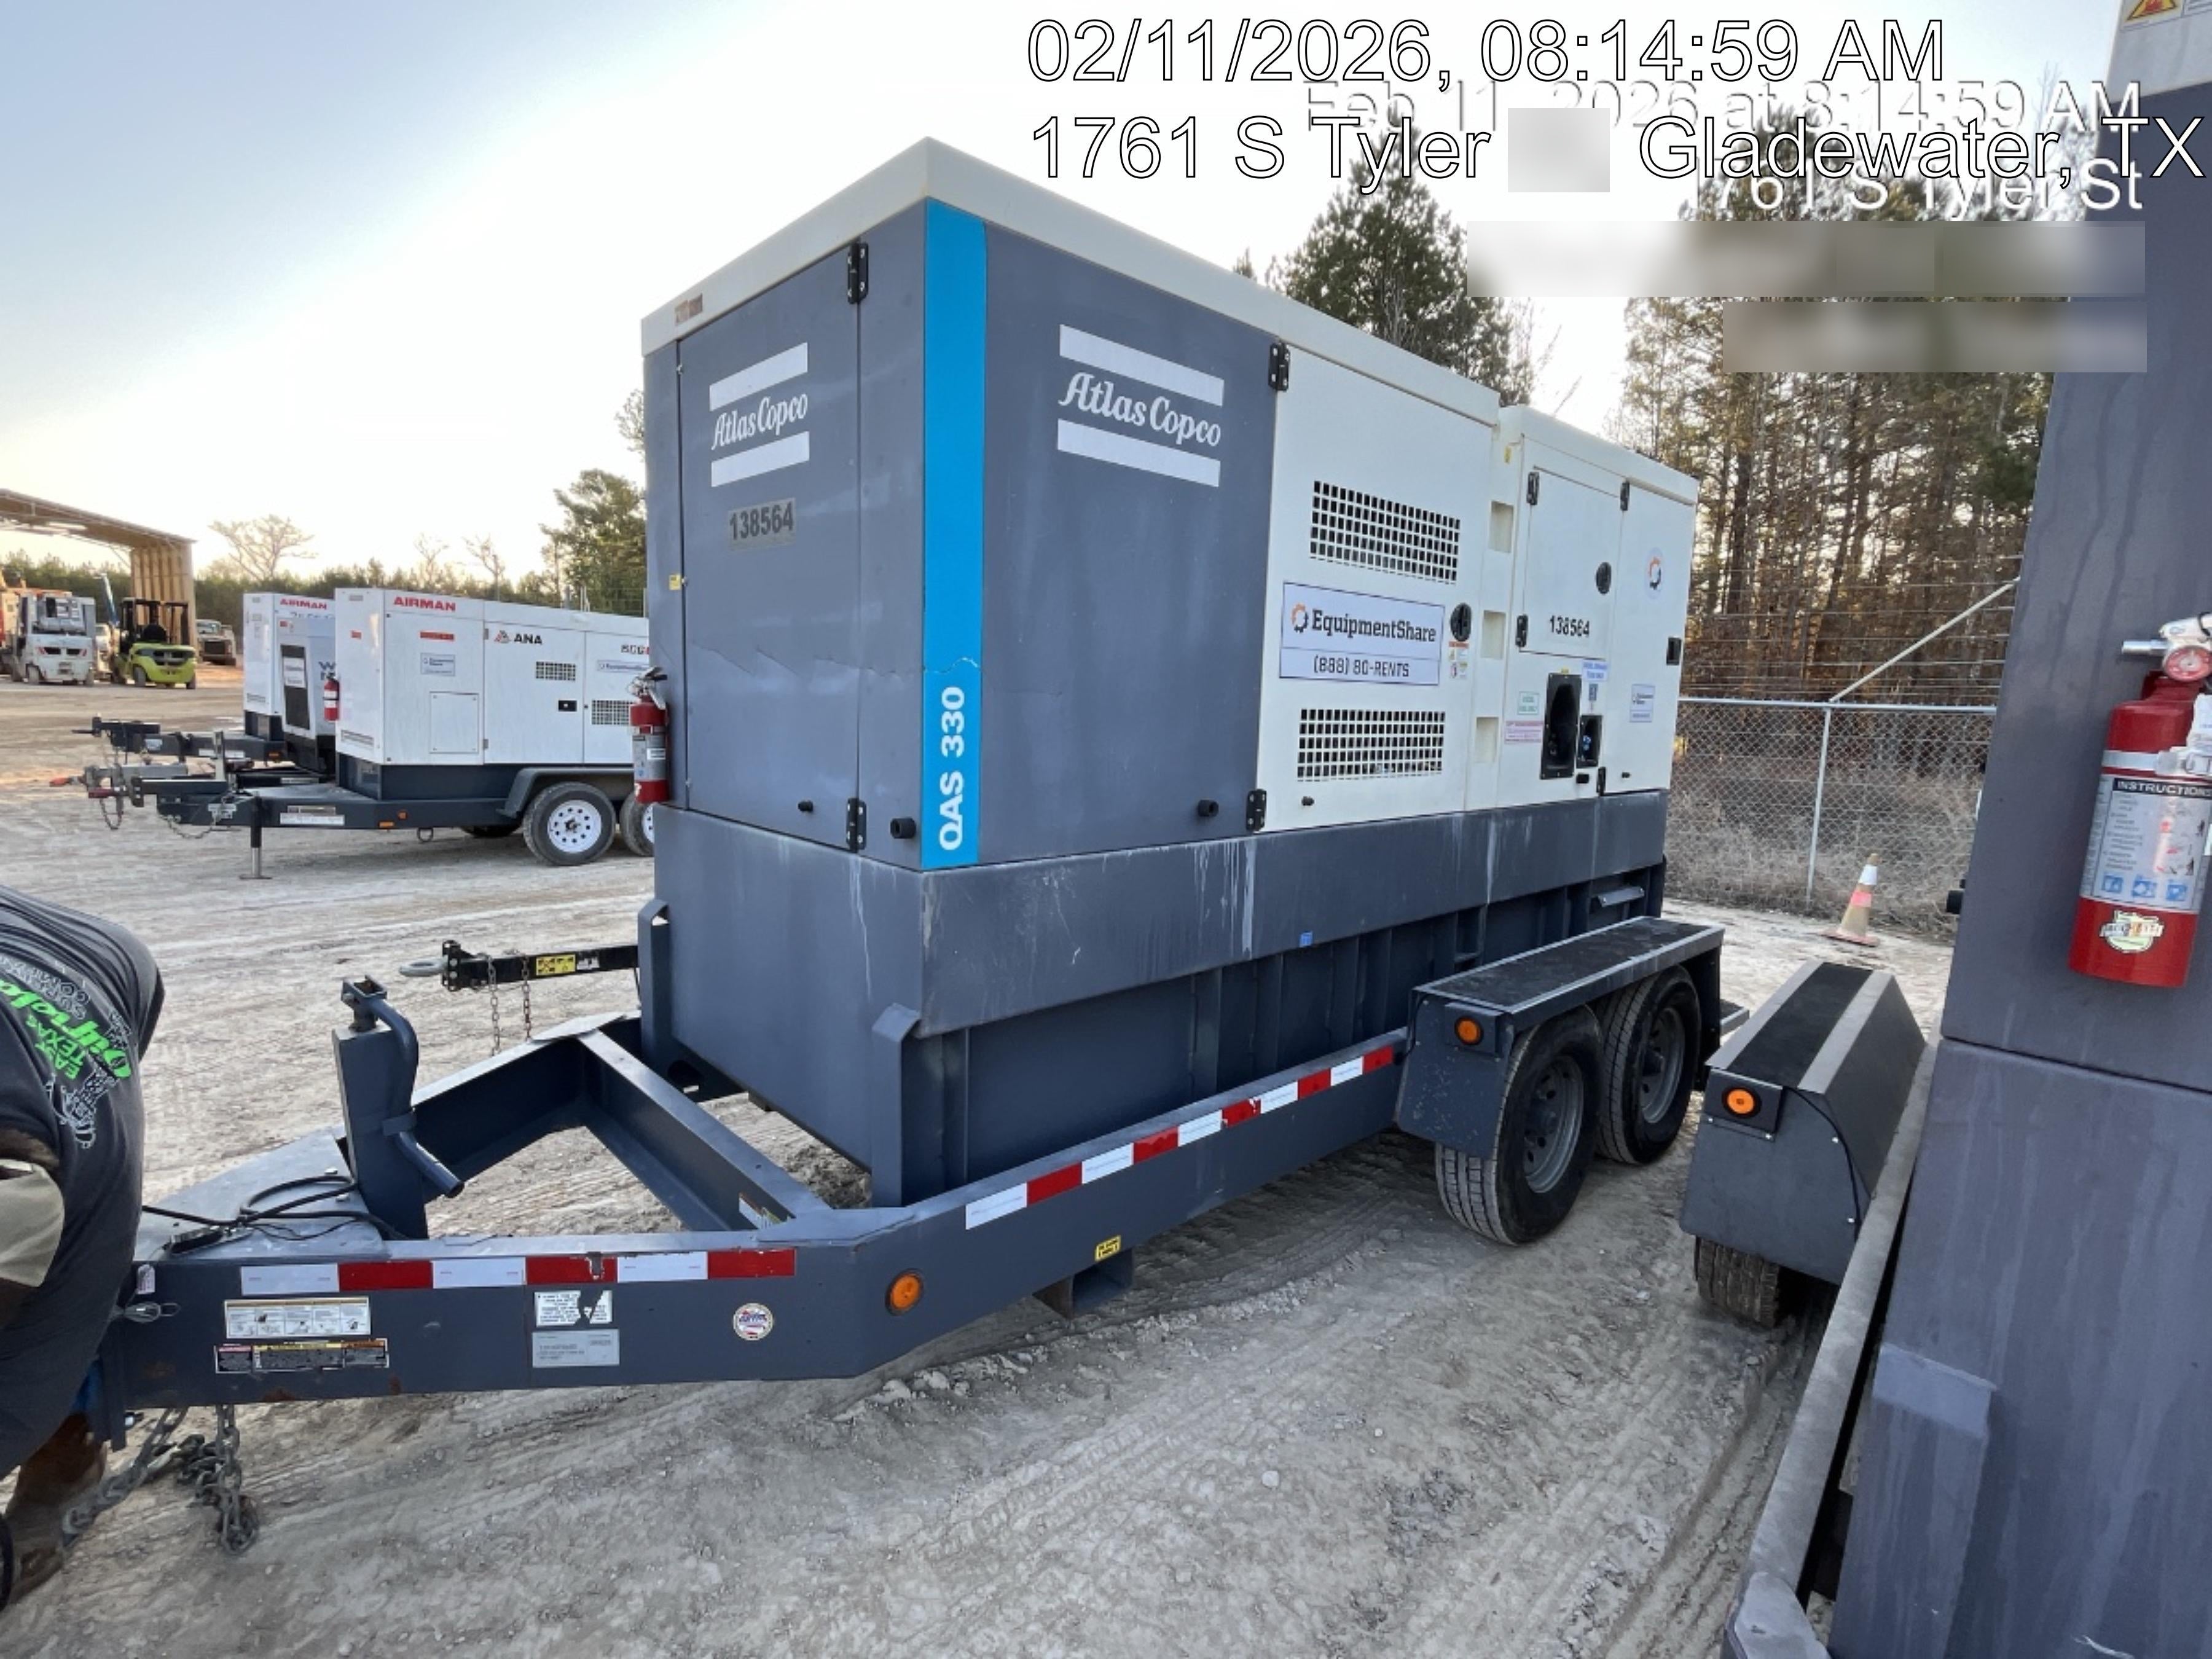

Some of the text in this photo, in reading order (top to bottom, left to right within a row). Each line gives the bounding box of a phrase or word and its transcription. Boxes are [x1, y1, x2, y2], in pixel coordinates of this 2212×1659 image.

[710, 393, 809, 451] Atlas Copco
[1058, 372, 1222, 447] Atlas Copco
[729, 501, 794, 541] 138564
[393, 596, 456, 612] AIRMAN
[514, 633, 543, 645] ANA
[1312, 609, 1437, 642] EquipmentShare
[1550, 615, 1590, 637] 138564
[1314, 654, 1350, 675] (888)
[939, 686, 965, 851] QAS 330
